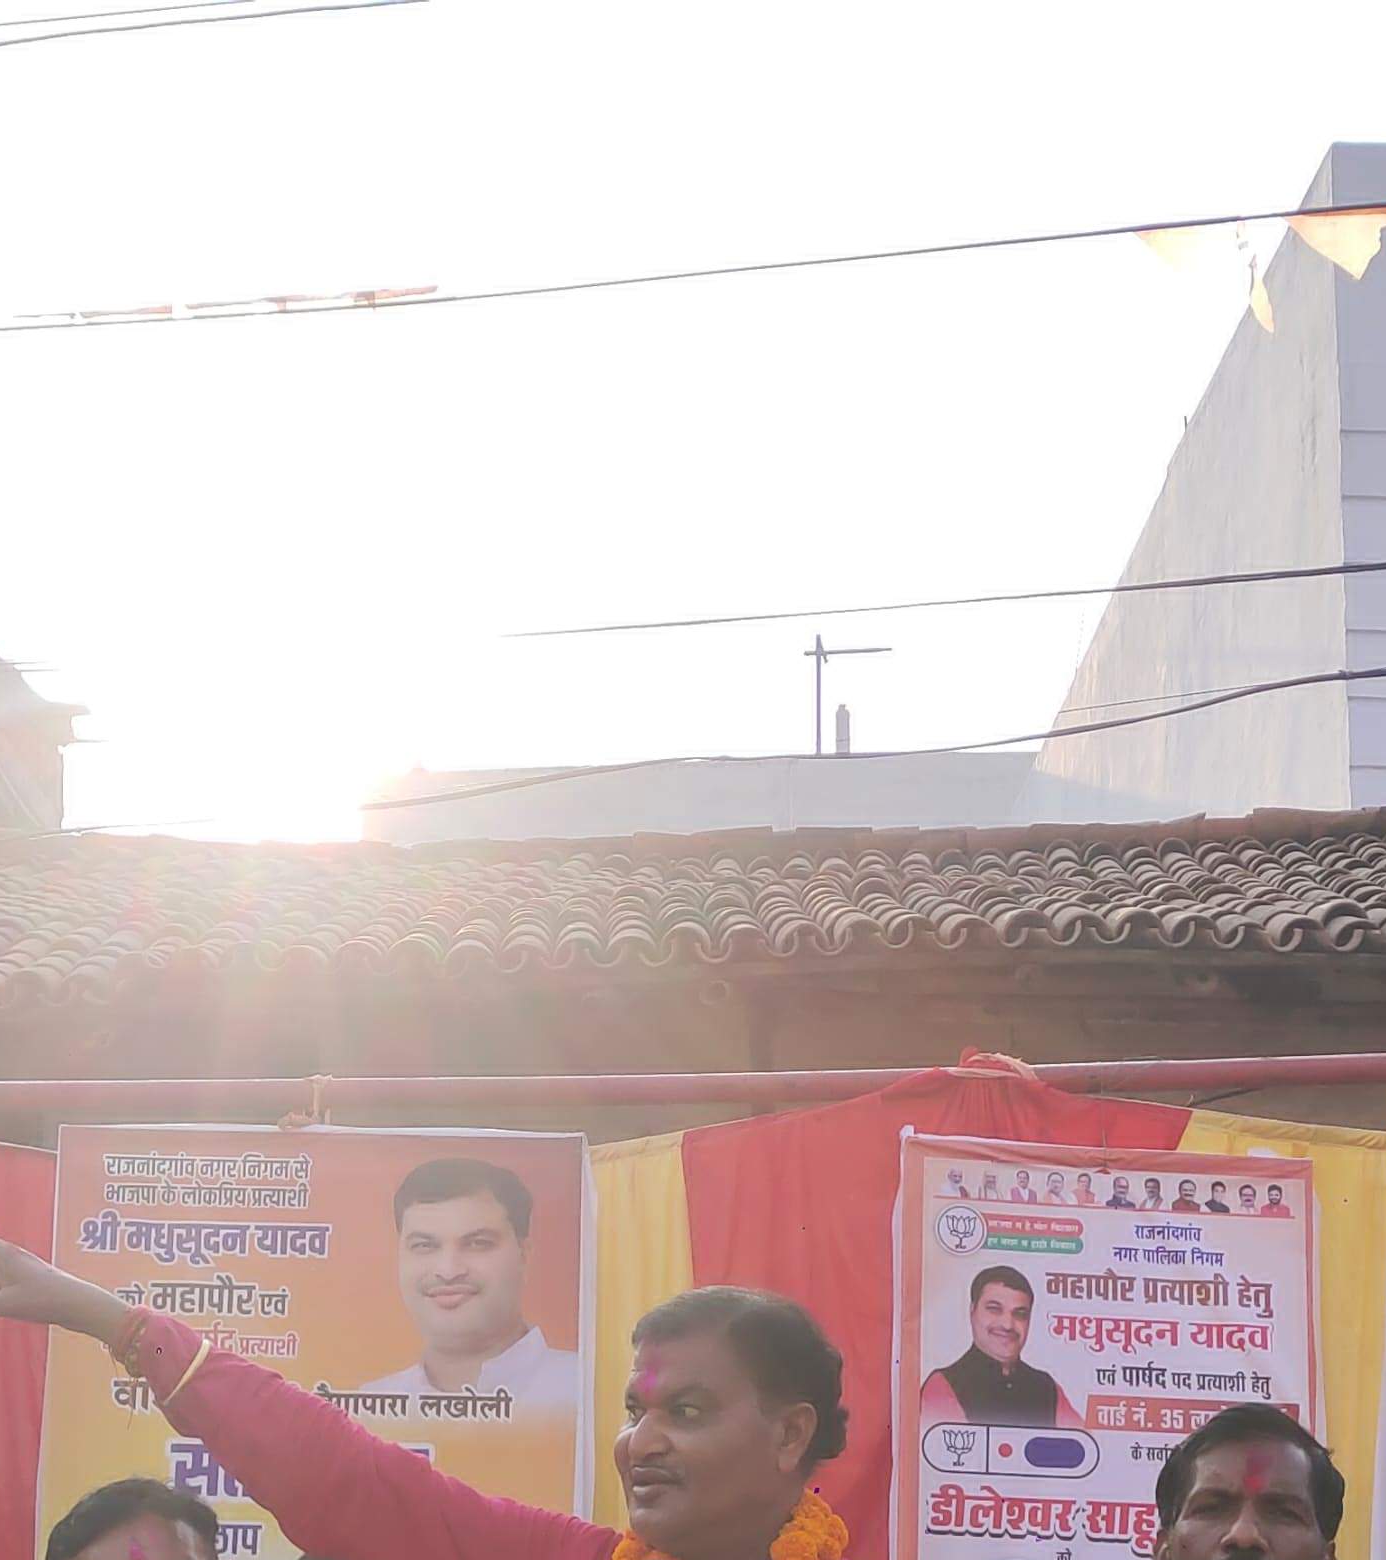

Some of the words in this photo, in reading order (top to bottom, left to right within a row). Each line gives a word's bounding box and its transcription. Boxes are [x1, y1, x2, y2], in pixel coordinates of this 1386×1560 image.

[199, 1158, 240, 1179] नगर
[242, 1154, 290, 1179] निगम
[293, 1155, 311, 1180] से
[105, 1183, 157, 1205] भाजपा
[160, 1182, 177, 1205] के
[179, 1181, 248, 1207] लोकप्रिय
[251, 1181, 309, 1208] प्रत्याशी
[82, 1212, 118, 1253] श्री
[128, 1222, 249, 1264] मधुसूदन
[254, 1224, 328, 1257] यादव
[1113, 1246, 1139, 1264] नगर
[1191, 1247, 1224, 1268] निगम
[153, 1276, 255, 1314] महापौर
[260, 1288, 288, 1316] एवं
[1045, 1268, 1135, 1302] महापौर
[1143, 1274, 1230, 1308] प्रत्याशी
[1237, 1275, 1274, 1318] हेतु
[239, 1333, 297, 1356] प्रत्याशी
[1051, 1314, 1179, 1354] मधुसूदन
[1190, 1321, 1270, 1351] यादव
[1096, 1366, 1117, 1386] एवं
[1122, 1364, 1167, 1391] पार्षद
[1171, 1372, 1192, 1391] पद
[1196, 1370, 1245, 1393] प्रत्याशी
[1251, 1370, 1272, 1399] हेतु
[419, 1387, 513, 1418] लखोली
[1096, 1402, 1129, 1427] वार्ड
[1132, 1402, 1153, 1428] नं.
[1161, 1409, 1185, 1429] 35
[1130, 1442, 1144, 1461] के
[930, 1484, 1077, 1534] डीलेश्वर
[1086, 1500, 1158, 1550] साहू
